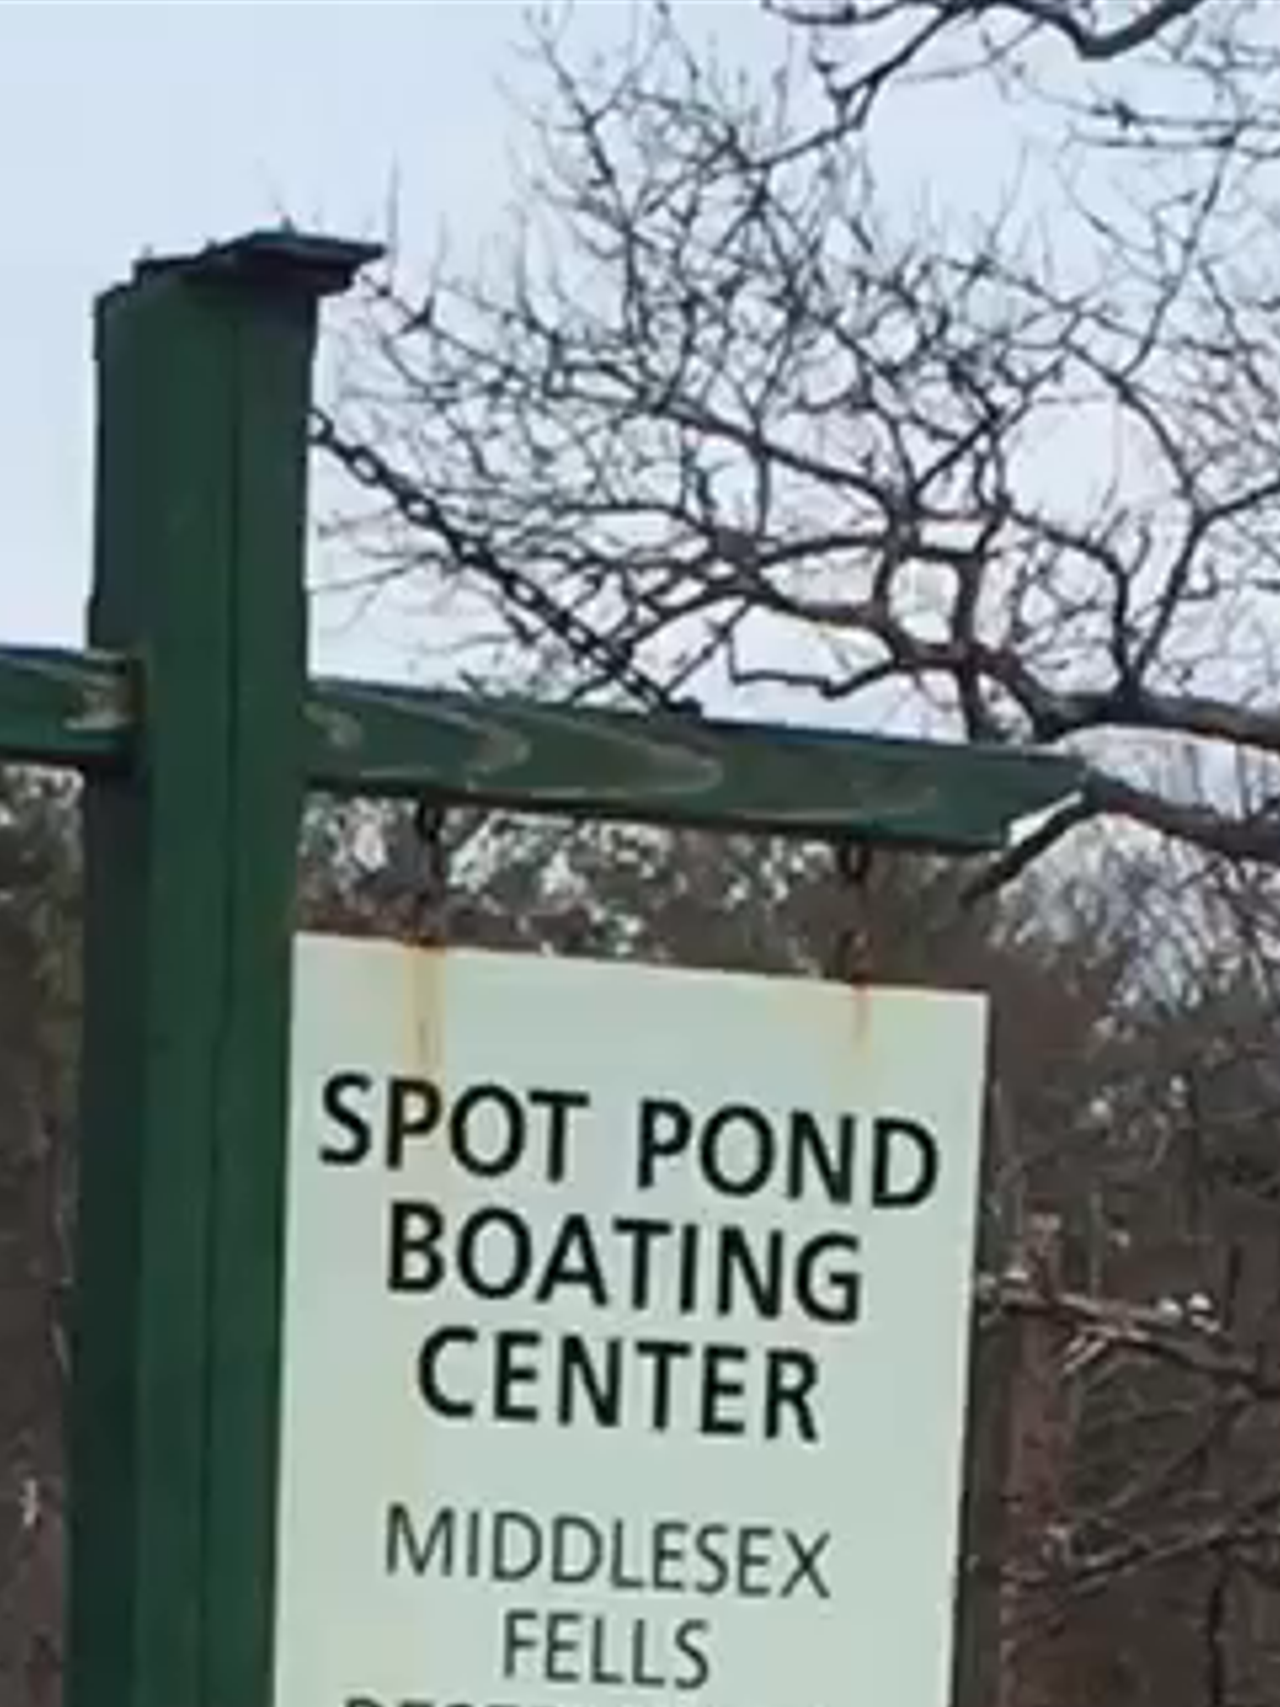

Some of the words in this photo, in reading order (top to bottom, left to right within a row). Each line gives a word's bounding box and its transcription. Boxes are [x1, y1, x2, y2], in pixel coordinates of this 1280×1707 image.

[318, 1071, 591, 1184] SPOT
[635, 1097, 940, 1210] POND
[386, 1200, 862, 1326] BOATING
[416, 1325, 819, 1443] CENTER
[384, 1502, 832, 1599] MIDDLESEX
[502, 1608, 710, 1691] FELLS
